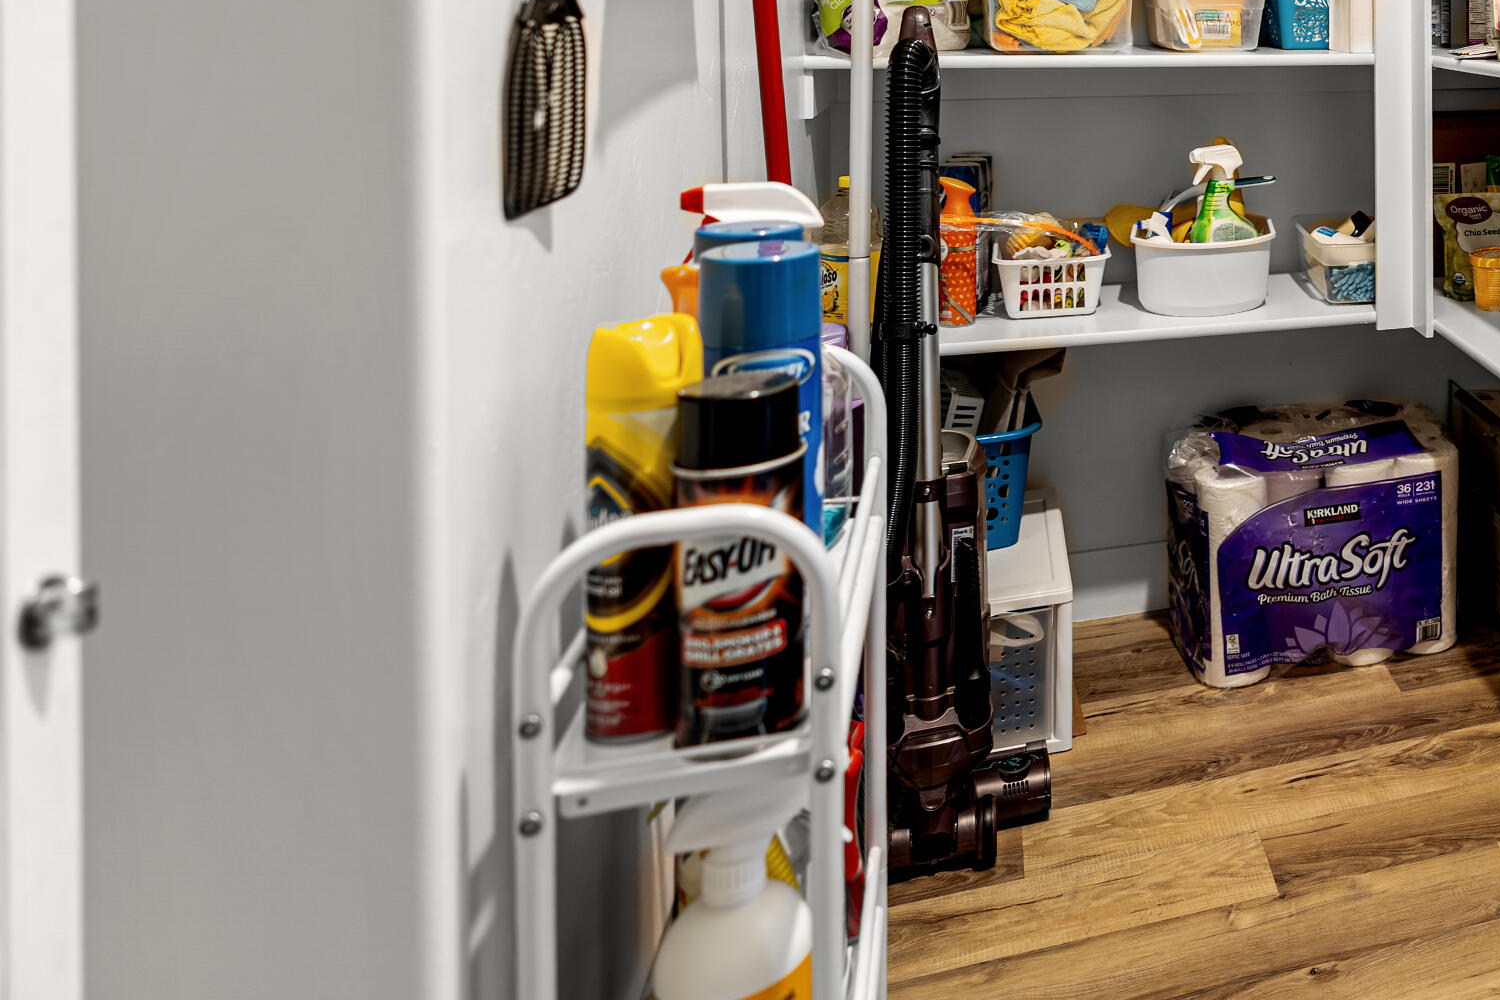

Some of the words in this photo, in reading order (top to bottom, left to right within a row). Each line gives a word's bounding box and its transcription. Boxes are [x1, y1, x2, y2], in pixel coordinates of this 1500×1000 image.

[1450, 204, 1488, 215] Organic
[1464, 229, 1482, 237] Chia
[1326, 432, 1358, 444] Premium
[1397, 483, 1412, 494] 36
[1416, 480, 1435, 492] 231
[1307, 504, 1359, 519] KIRKLAND
[1257, 593, 1309, 605] Premium
[1310, 589, 1338, 603] Bath
[1339, 584, 1373, 598] Tissue
